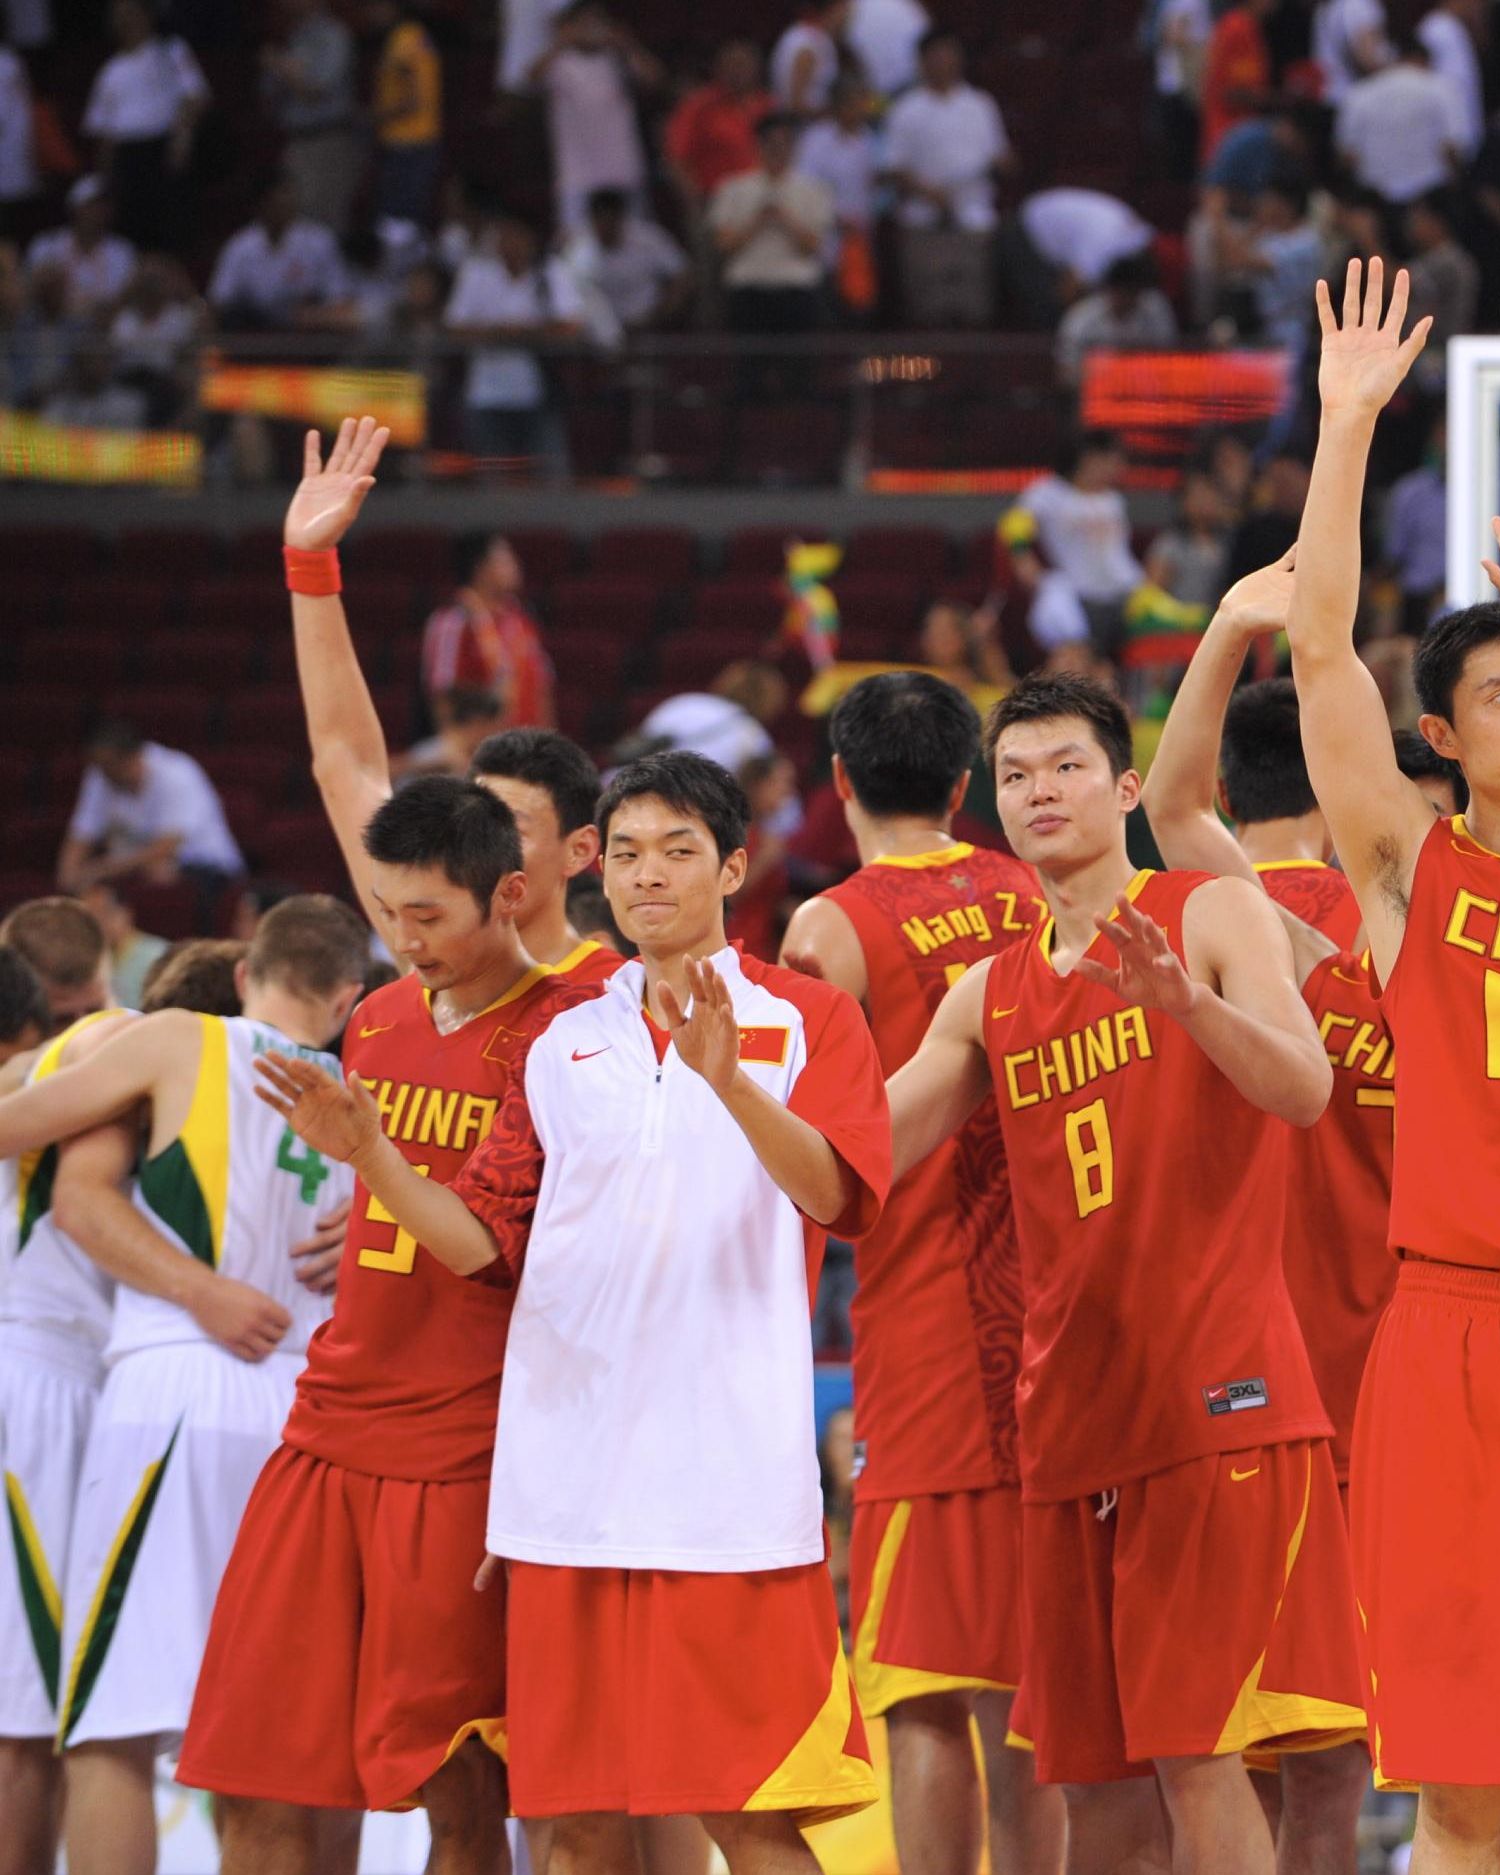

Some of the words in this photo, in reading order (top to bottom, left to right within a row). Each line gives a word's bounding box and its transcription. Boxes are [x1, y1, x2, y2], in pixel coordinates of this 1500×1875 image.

[901, 904, 993, 956] Wang
[1003, 1005, 1153, 1110] CHINA
[357, 1077, 500, 1151] HINA
[276, 1124, 329, 1205] 4
[1065, 1098, 1113, 1218] 8
[1229, 1383, 1261, 1398] 3XL
